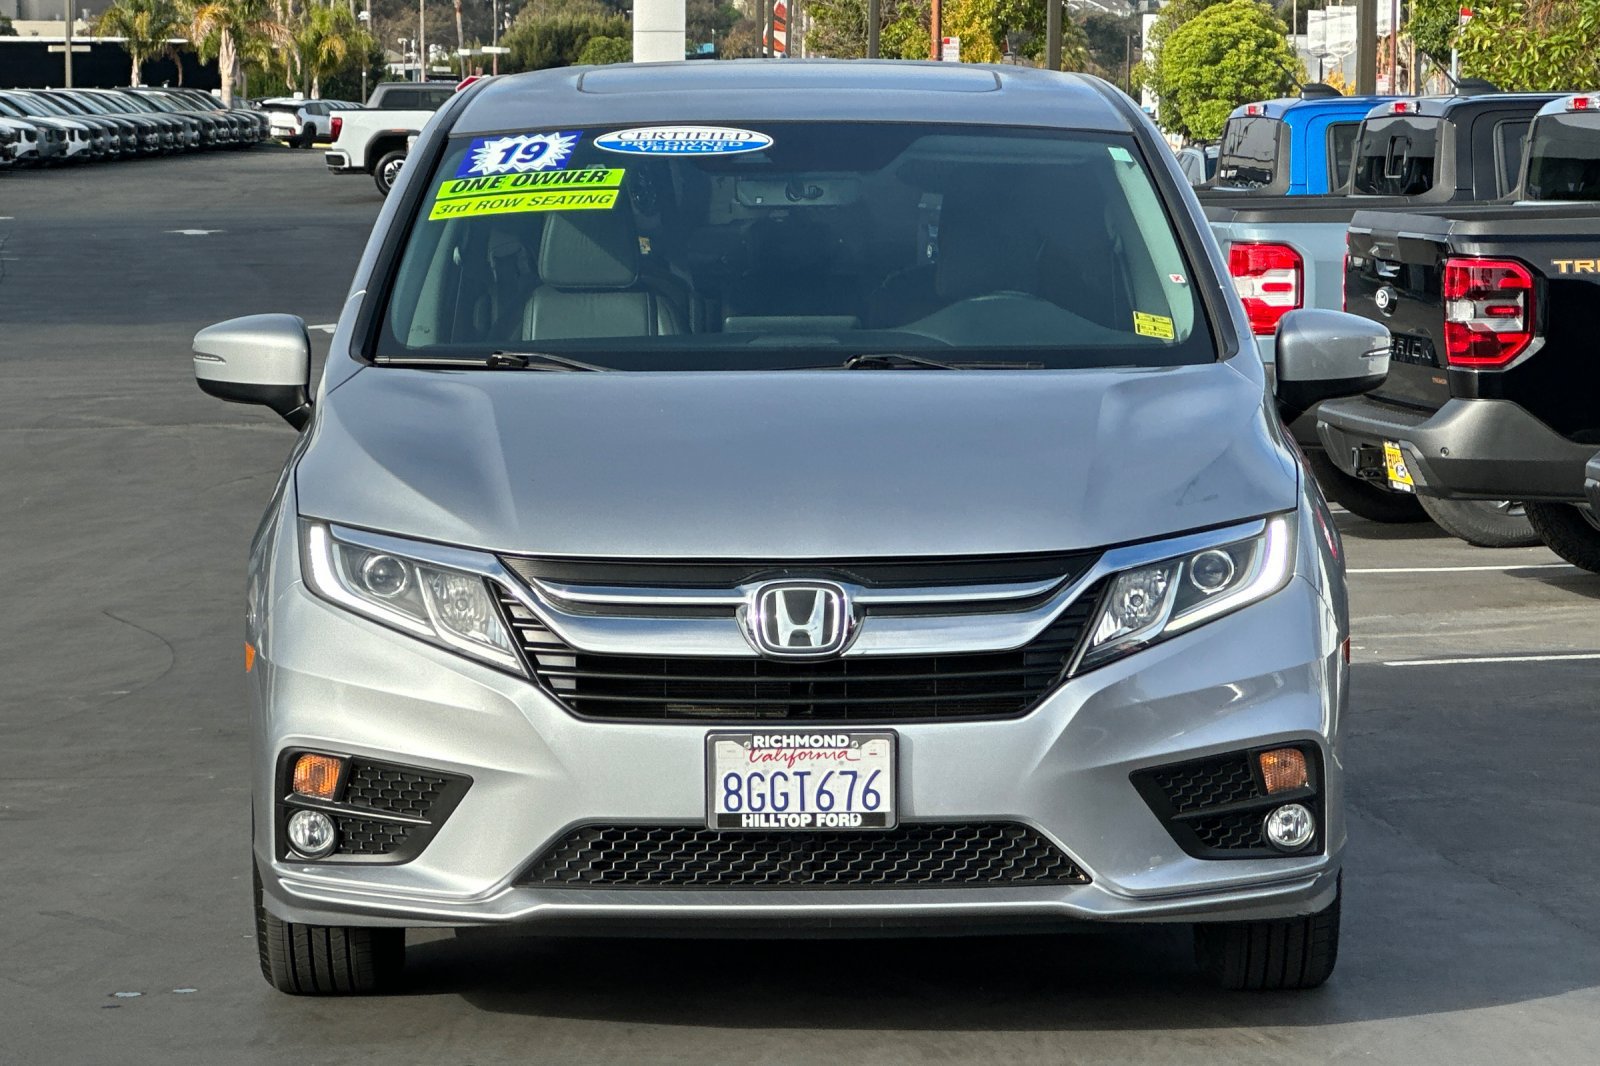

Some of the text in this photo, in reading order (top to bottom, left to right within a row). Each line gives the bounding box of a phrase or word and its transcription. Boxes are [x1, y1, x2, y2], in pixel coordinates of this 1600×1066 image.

[617, 131, 753, 141] CERTIFIED
[498, 142, 549, 165] 19
[449, 170, 612, 194] ONE OWNER
[436, 193, 613, 215] 3rd ROW SEATING
[1552, 260, 1600, 273] TR
[753, 734, 849, 748] RICHMOND
[749, 747, 861, 769] California
[723, 769, 881, 812] 8GGT676
[741, 813, 862, 828] HILLTOP FORD
